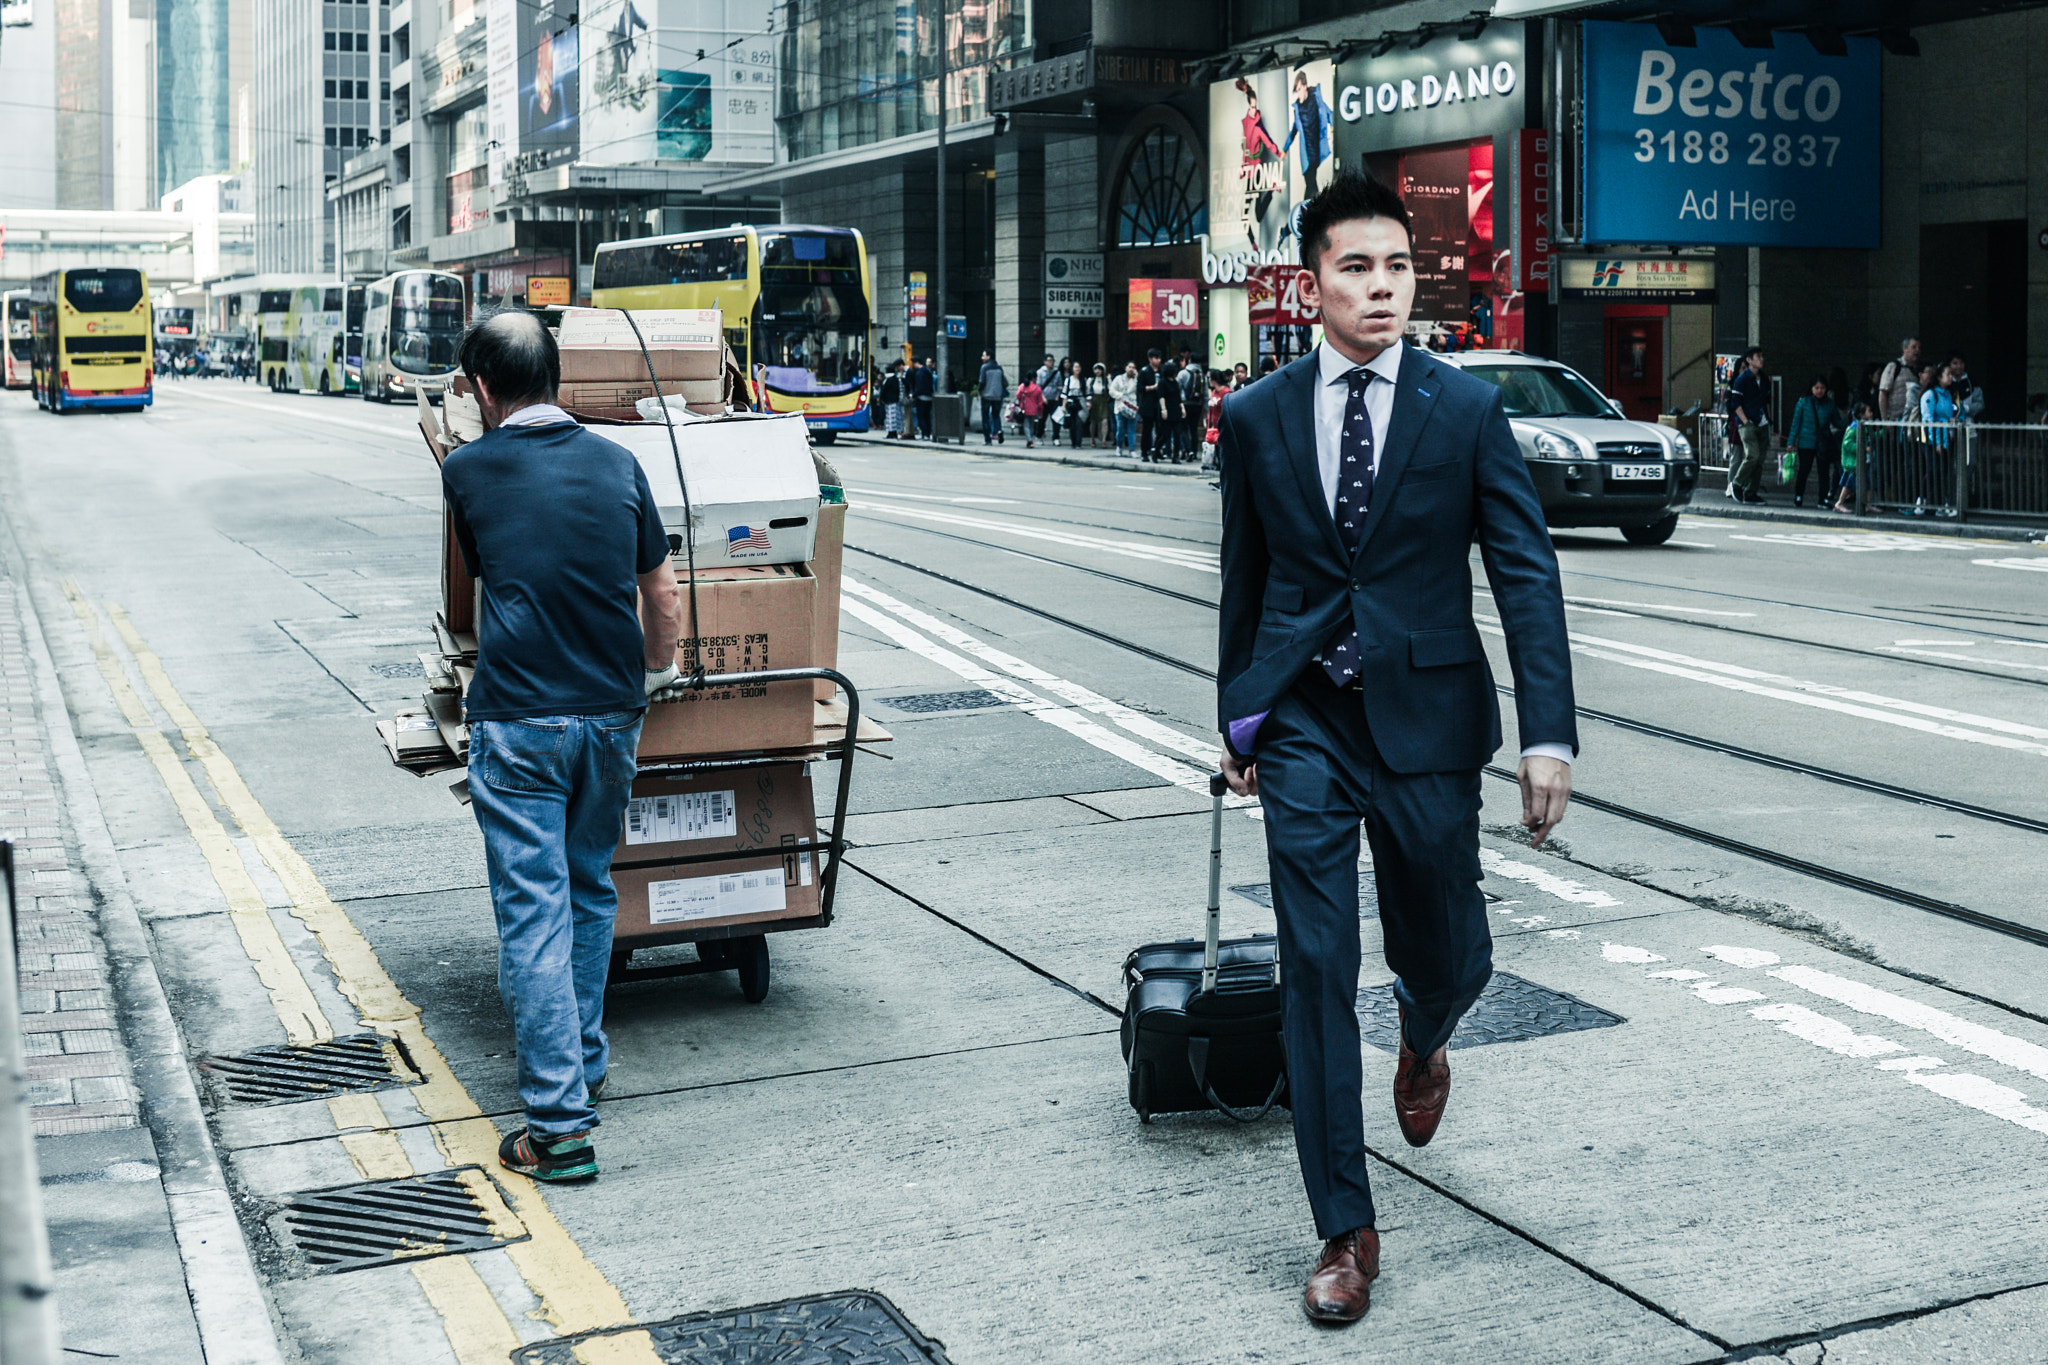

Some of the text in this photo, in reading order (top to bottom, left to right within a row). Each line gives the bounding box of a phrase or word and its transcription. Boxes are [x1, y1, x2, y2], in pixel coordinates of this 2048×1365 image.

[1097, 56, 1149, 81] SIBERIAN
[1154, 57, 1176, 84] FUR
[1339, 61, 1516, 122] GIORDANO
[1633, 50, 1841, 122] Bestco
[1634, 128, 1841, 167] 3188 2837
[1211, 161, 1286, 195] FUNCTIONAL
[1404, 184, 1460, 194] GIORDANO
[1535, 138, 1548, 253] BOOKS
[1210, 192, 1259, 223] JACKET
[1679, 189, 1796, 221] Ad Here
[1070, 259, 1101, 272] NHC
[1414, 272, 1432, 280] hank
[1049, 290, 1101, 302] SIBERIAN
[1162, 294, 1196, 326] $50
[1616, 467, 1661, 477] LZ 7496
[744, 633, 768, 644] MEAS
[684, 649, 695, 659] KG
[708, 647, 725, 658] 10.5
[684, 660, 695, 670] KG
[716, 658, 725, 667] 10
